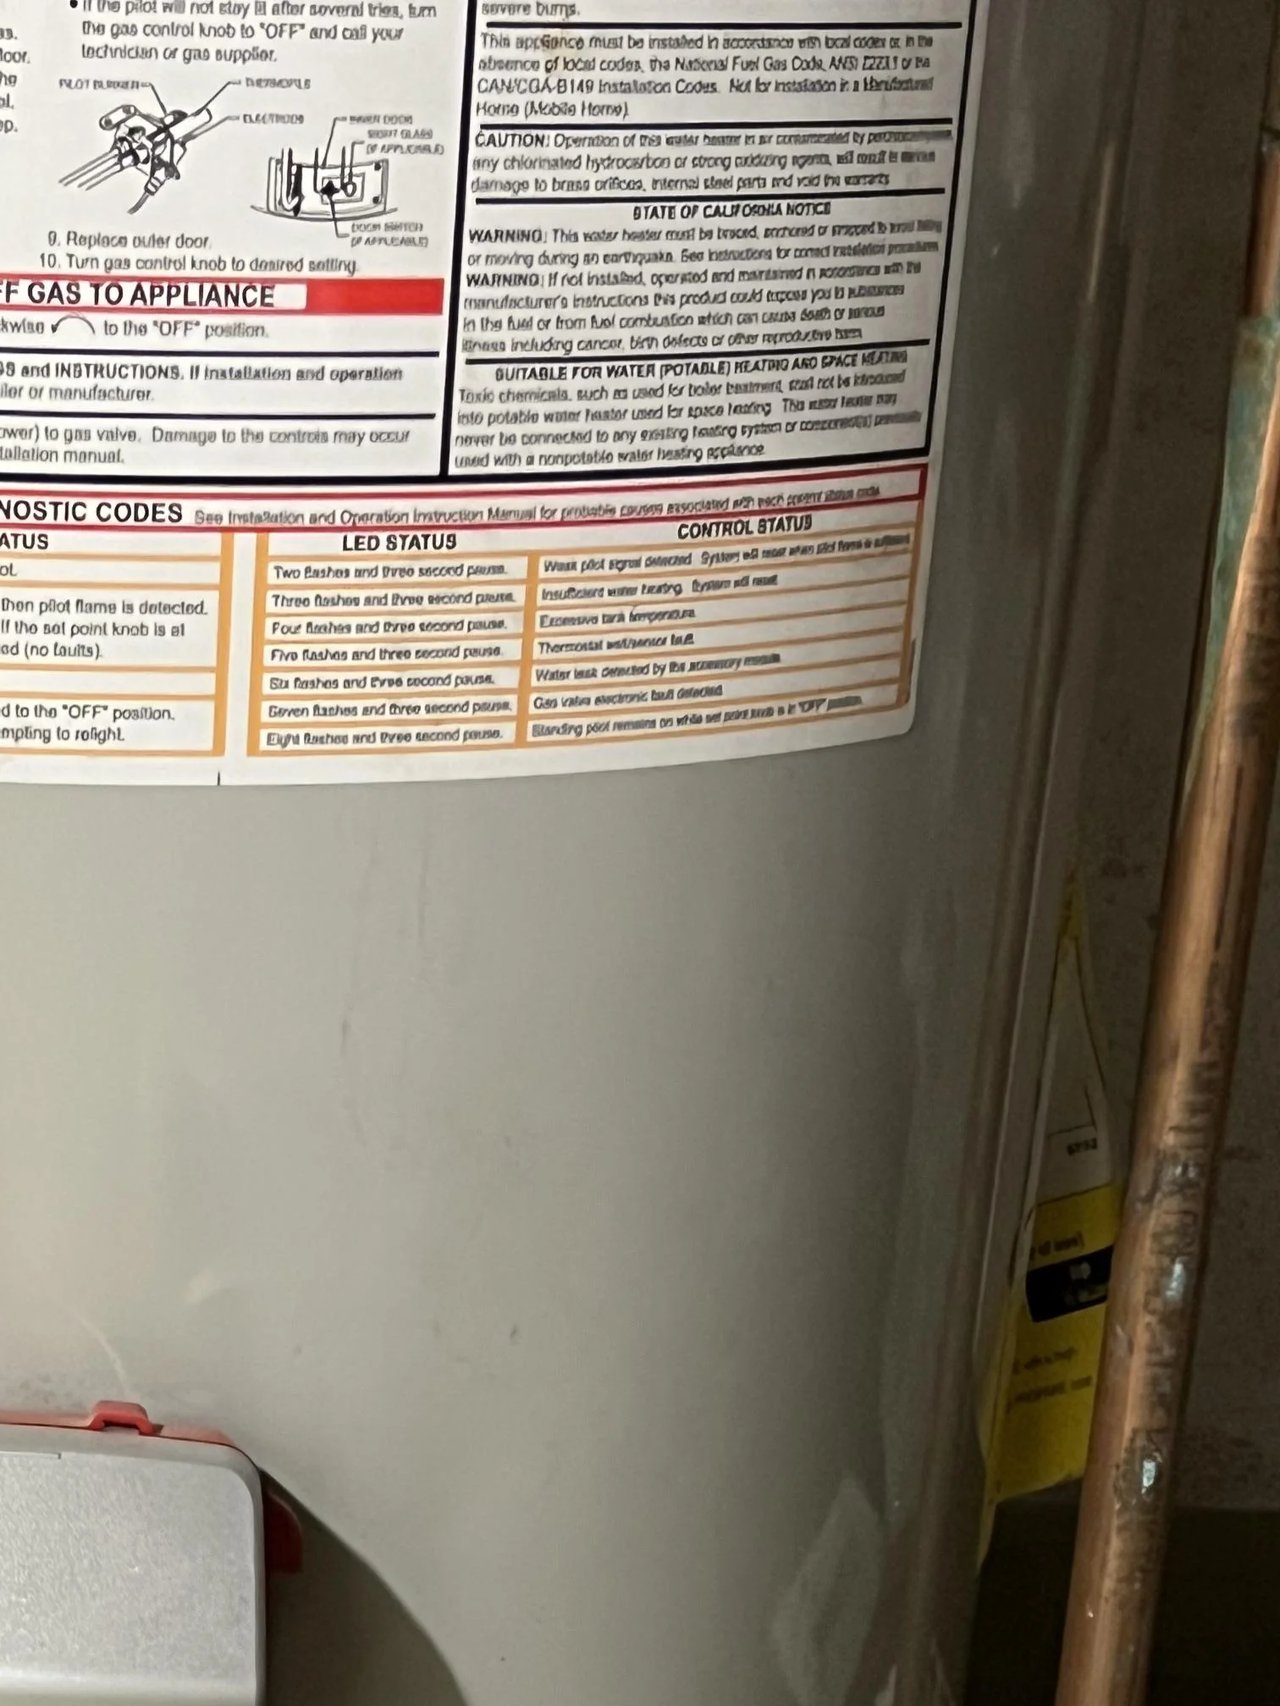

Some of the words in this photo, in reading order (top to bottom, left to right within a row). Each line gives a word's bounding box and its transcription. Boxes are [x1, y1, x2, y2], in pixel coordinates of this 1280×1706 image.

[475, 131, 549, 147] CAUTION:
[48, 230, 59, 246] 9.
[66, 230, 127, 249] Replace
[132, 233, 170, 248] outer
[27, 281, 80, 304] GAS
[90, 282, 123, 305] TO
[130, 282, 274, 307] APPLIANCE
[104, 320, 118, 335] to
[123, 320, 147, 335] the
[153, 320, 200, 336] "OFF"
[205, 322, 267, 340] position.
[21, 362, 50, 377] and
[55, 362, 183, 379] INSTRUCTIONS.
[190, 365, 199, 379] If
[204, 365, 290, 380] installation
[296, 365, 324, 380] and
[330, 367, 402, 383] operation
[606, 363, 655, 378] WATER
[96, 502, 182, 522] CODES
[677, 519, 753, 539] CONTROL
[757, 514, 812, 534] STATUS
[342, 535, 379, 551] LED
[386, 533, 456, 550] STATUS
[273, 565, 300, 578] Two
[354, 565, 378, 577] and
[56, 726, 69, 740] to
